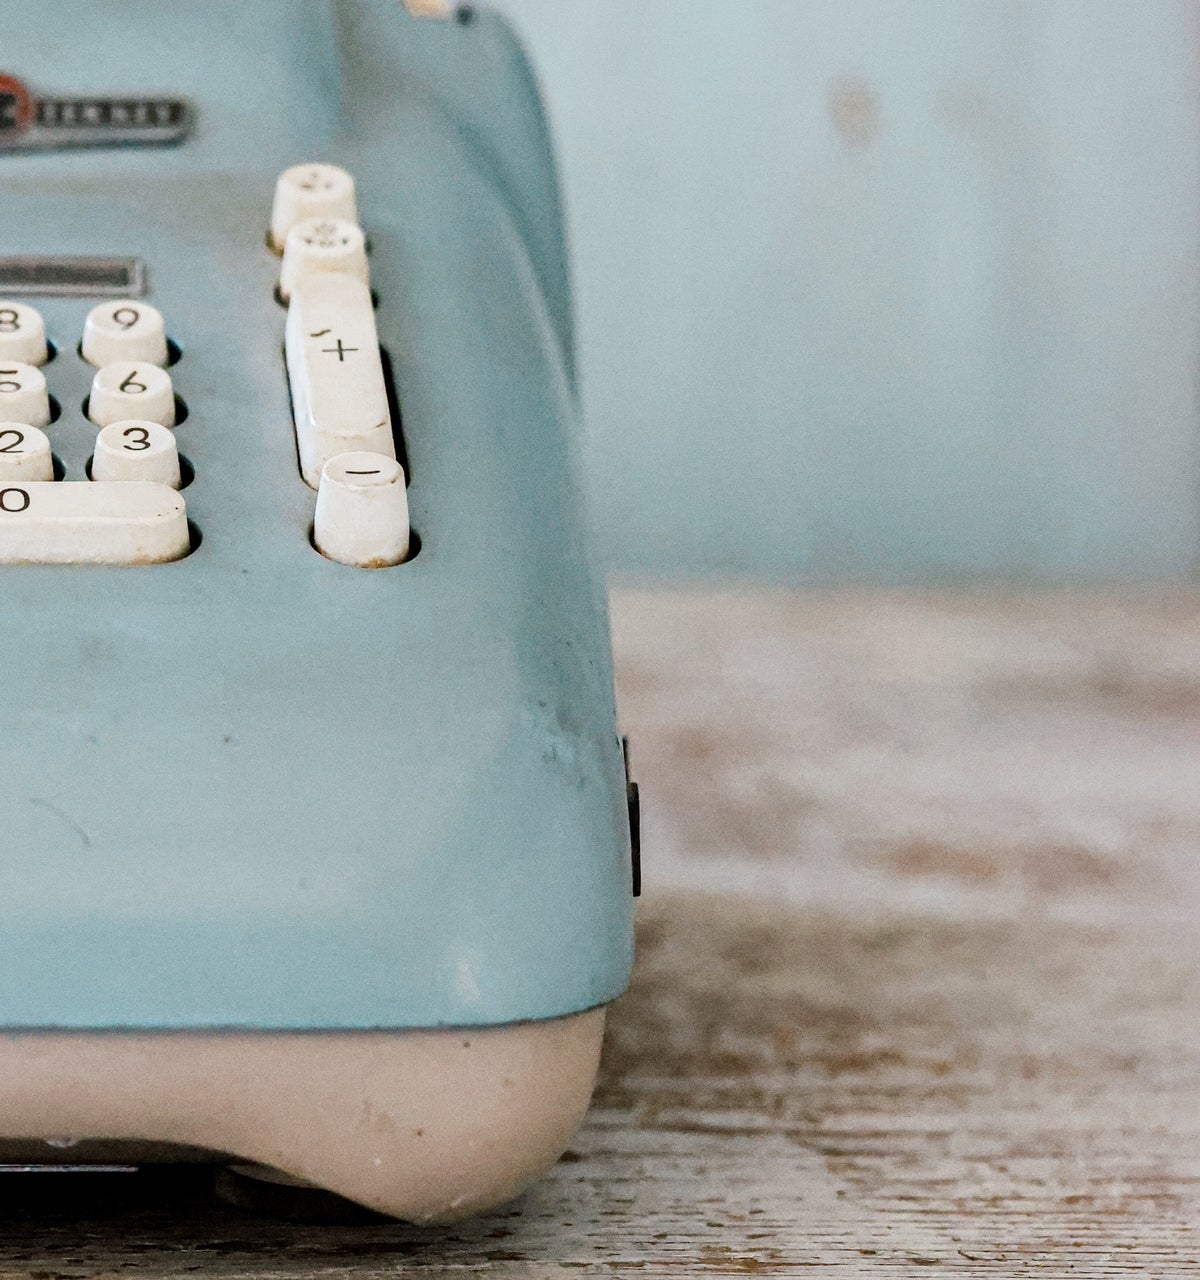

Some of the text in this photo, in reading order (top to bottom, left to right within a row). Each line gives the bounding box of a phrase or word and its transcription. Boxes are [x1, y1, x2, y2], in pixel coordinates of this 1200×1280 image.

[112, 308, 140, 330] 9
[118, 370, 148, 394] 6
[122, 427, 152, 451] 3
